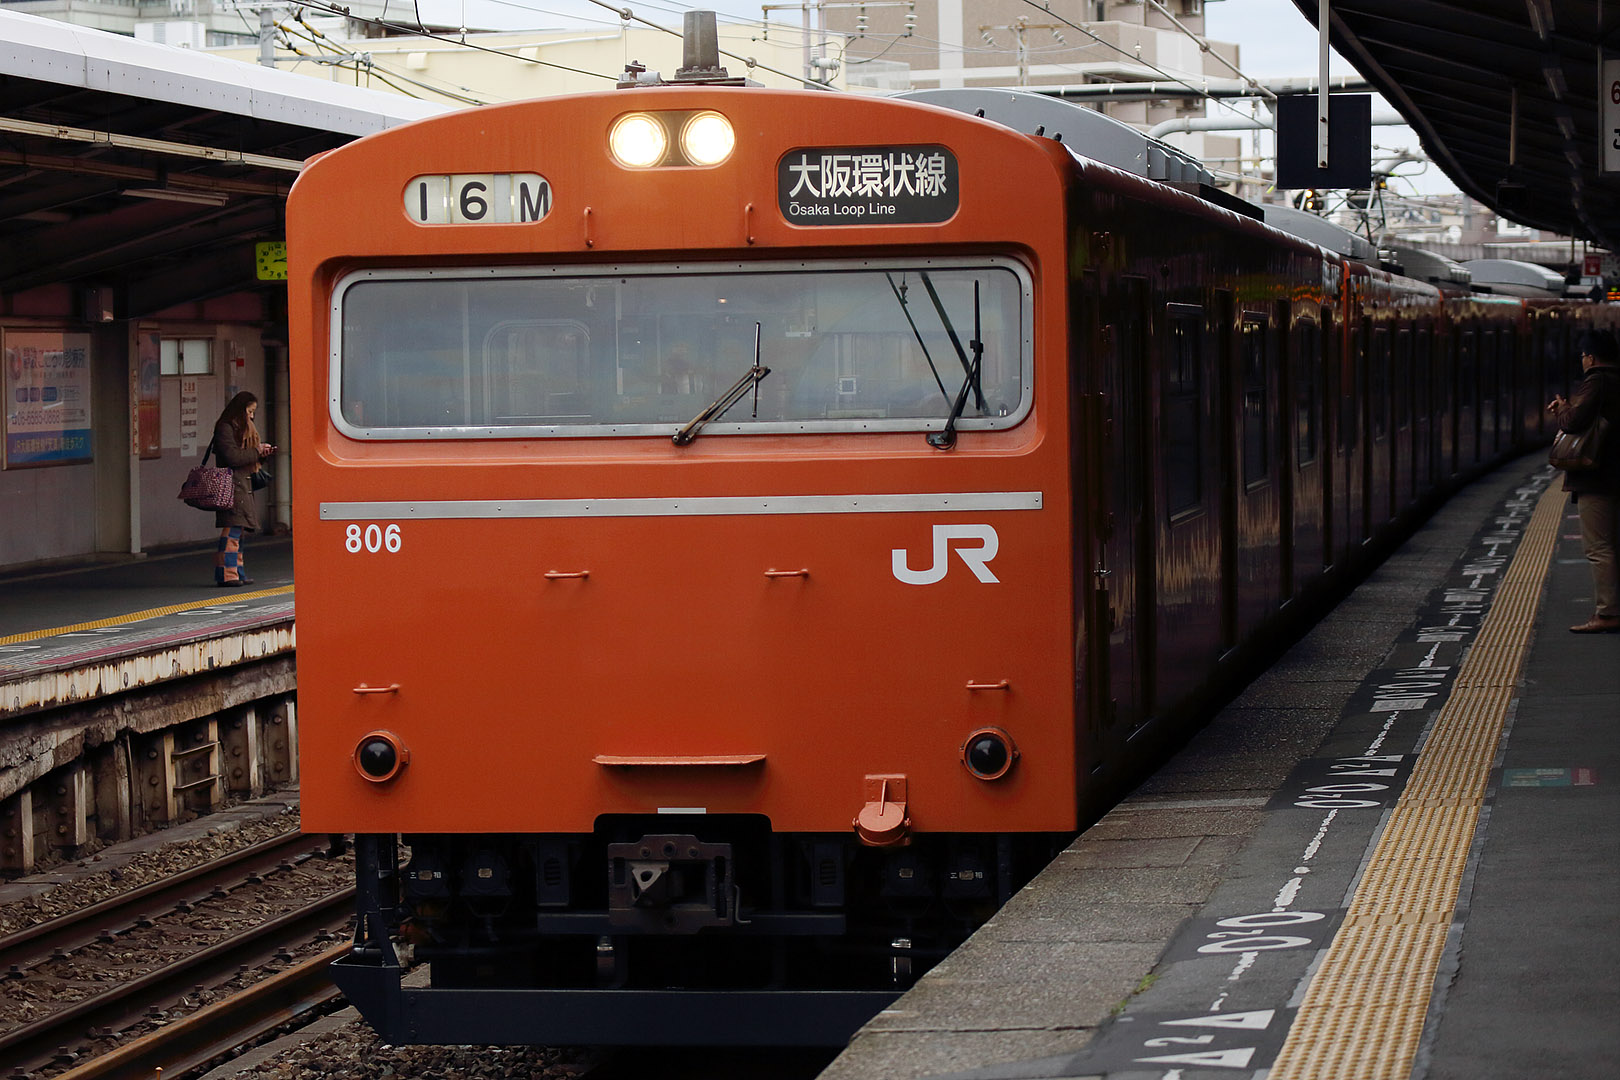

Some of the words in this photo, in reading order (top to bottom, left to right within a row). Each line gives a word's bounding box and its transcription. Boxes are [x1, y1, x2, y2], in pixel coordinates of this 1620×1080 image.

[789, 152, 947, 198] 大阪環状線
[834, 203, 865, 217] Loop
[869, 202, 896, 215] Line
[345, 523, 402, 553] 806
[891, 524, 1001, 585] JR
